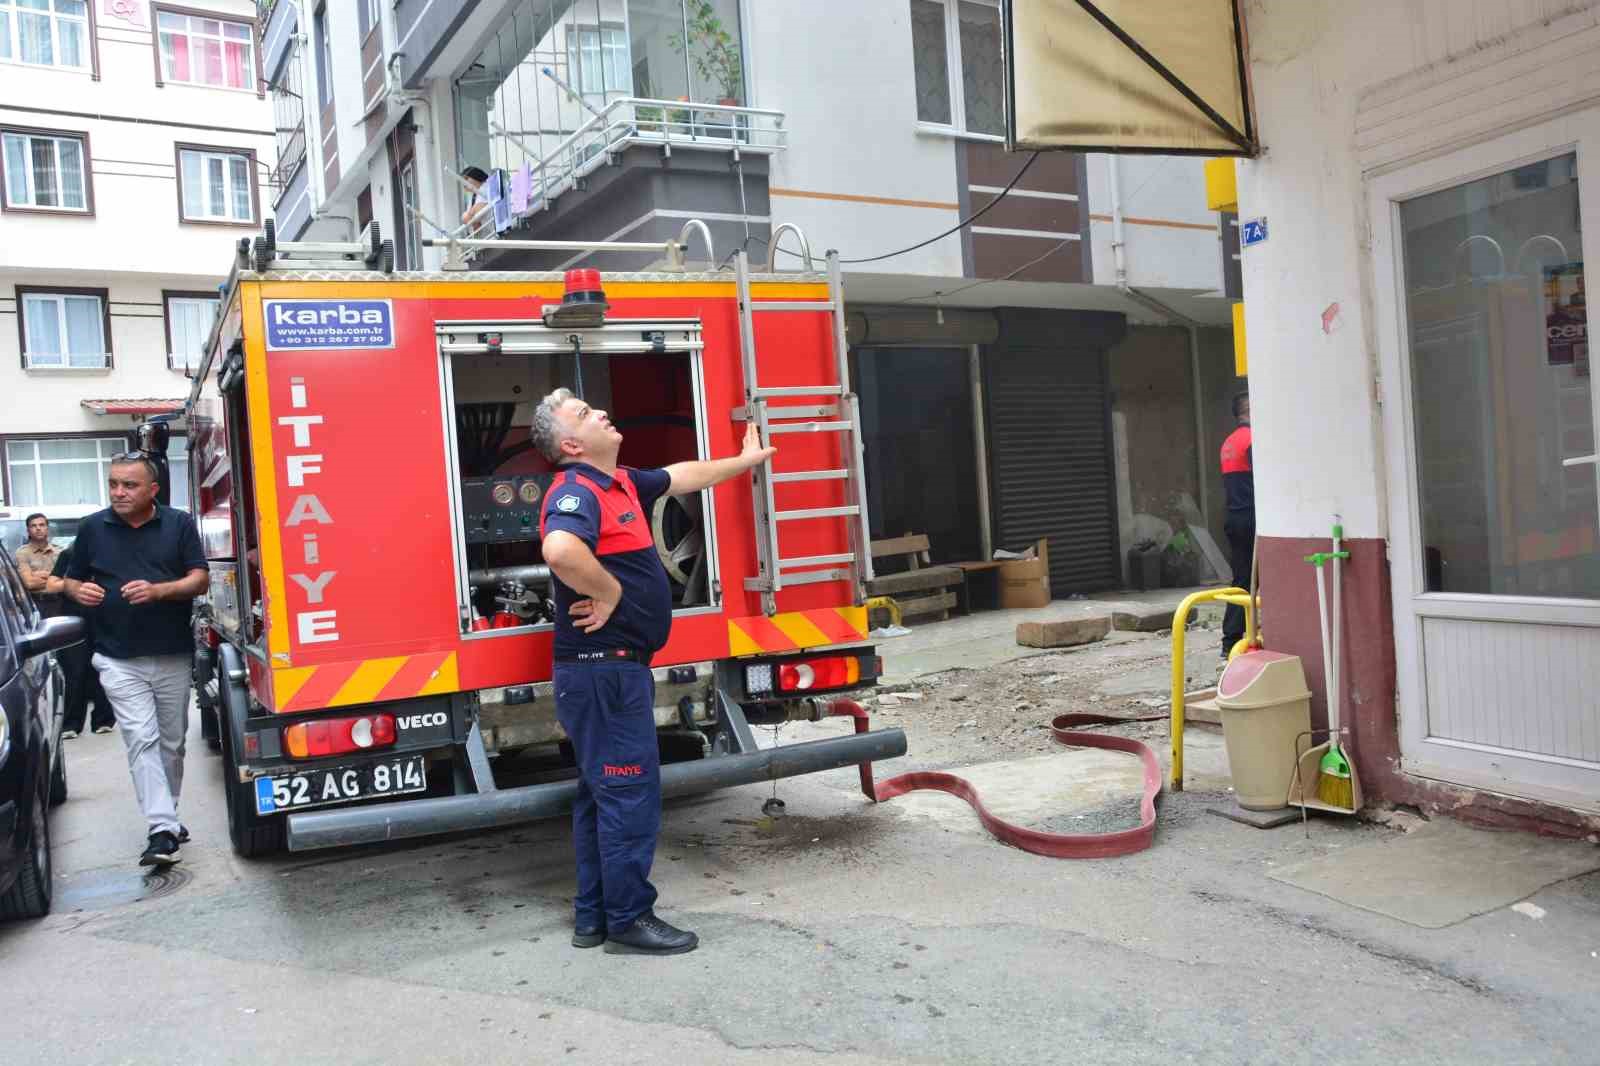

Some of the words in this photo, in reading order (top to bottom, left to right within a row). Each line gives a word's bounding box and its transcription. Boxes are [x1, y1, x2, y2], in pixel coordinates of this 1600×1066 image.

[274, 304, 383, 325] karba
[277, 326, 383, 336] www.karba.com.tr
[395, 712, 448, 730] VECO
[272, 776, 311, 807] 52
[321, 770, 360, 800] AG
[373, 760, 422, 792] 814
